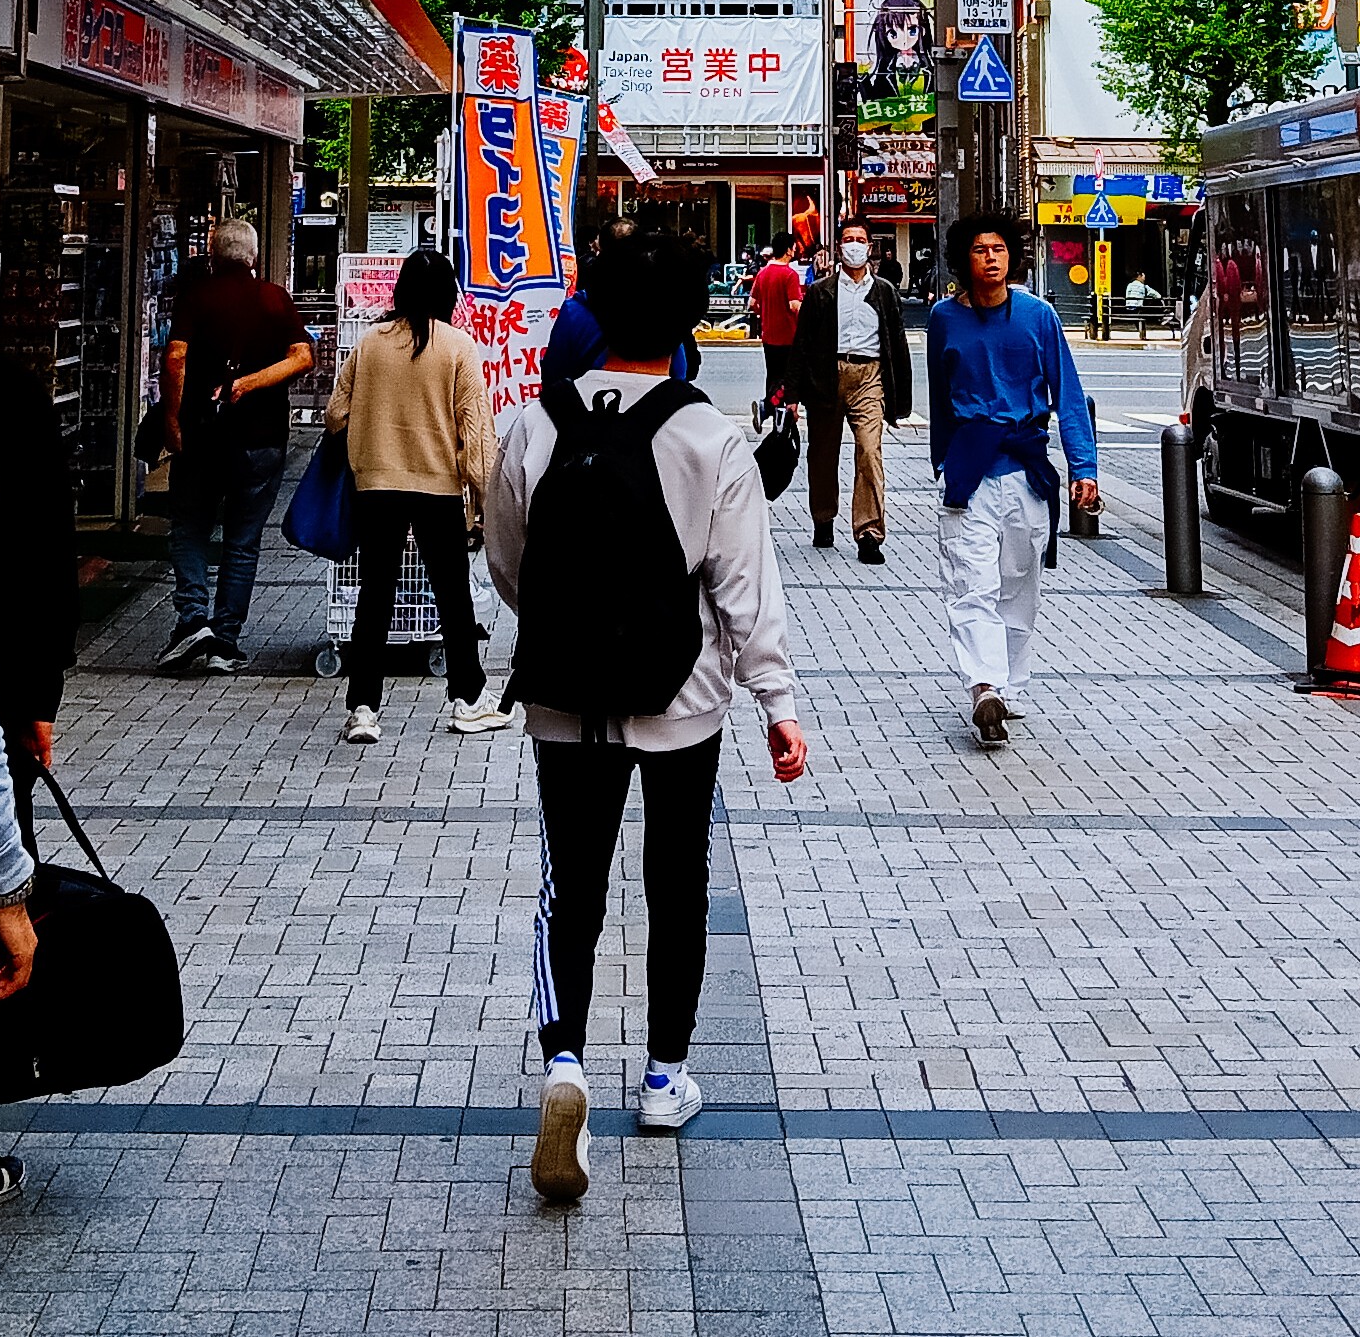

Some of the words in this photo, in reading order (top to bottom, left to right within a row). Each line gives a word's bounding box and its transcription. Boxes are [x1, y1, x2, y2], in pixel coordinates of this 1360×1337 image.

[661, 47, 781, 82] 営業中
[603, 66, 653, 78] Tax-free
[621, 80, 653, 93] Shop
[700, 88, 743, 98] OPEN
